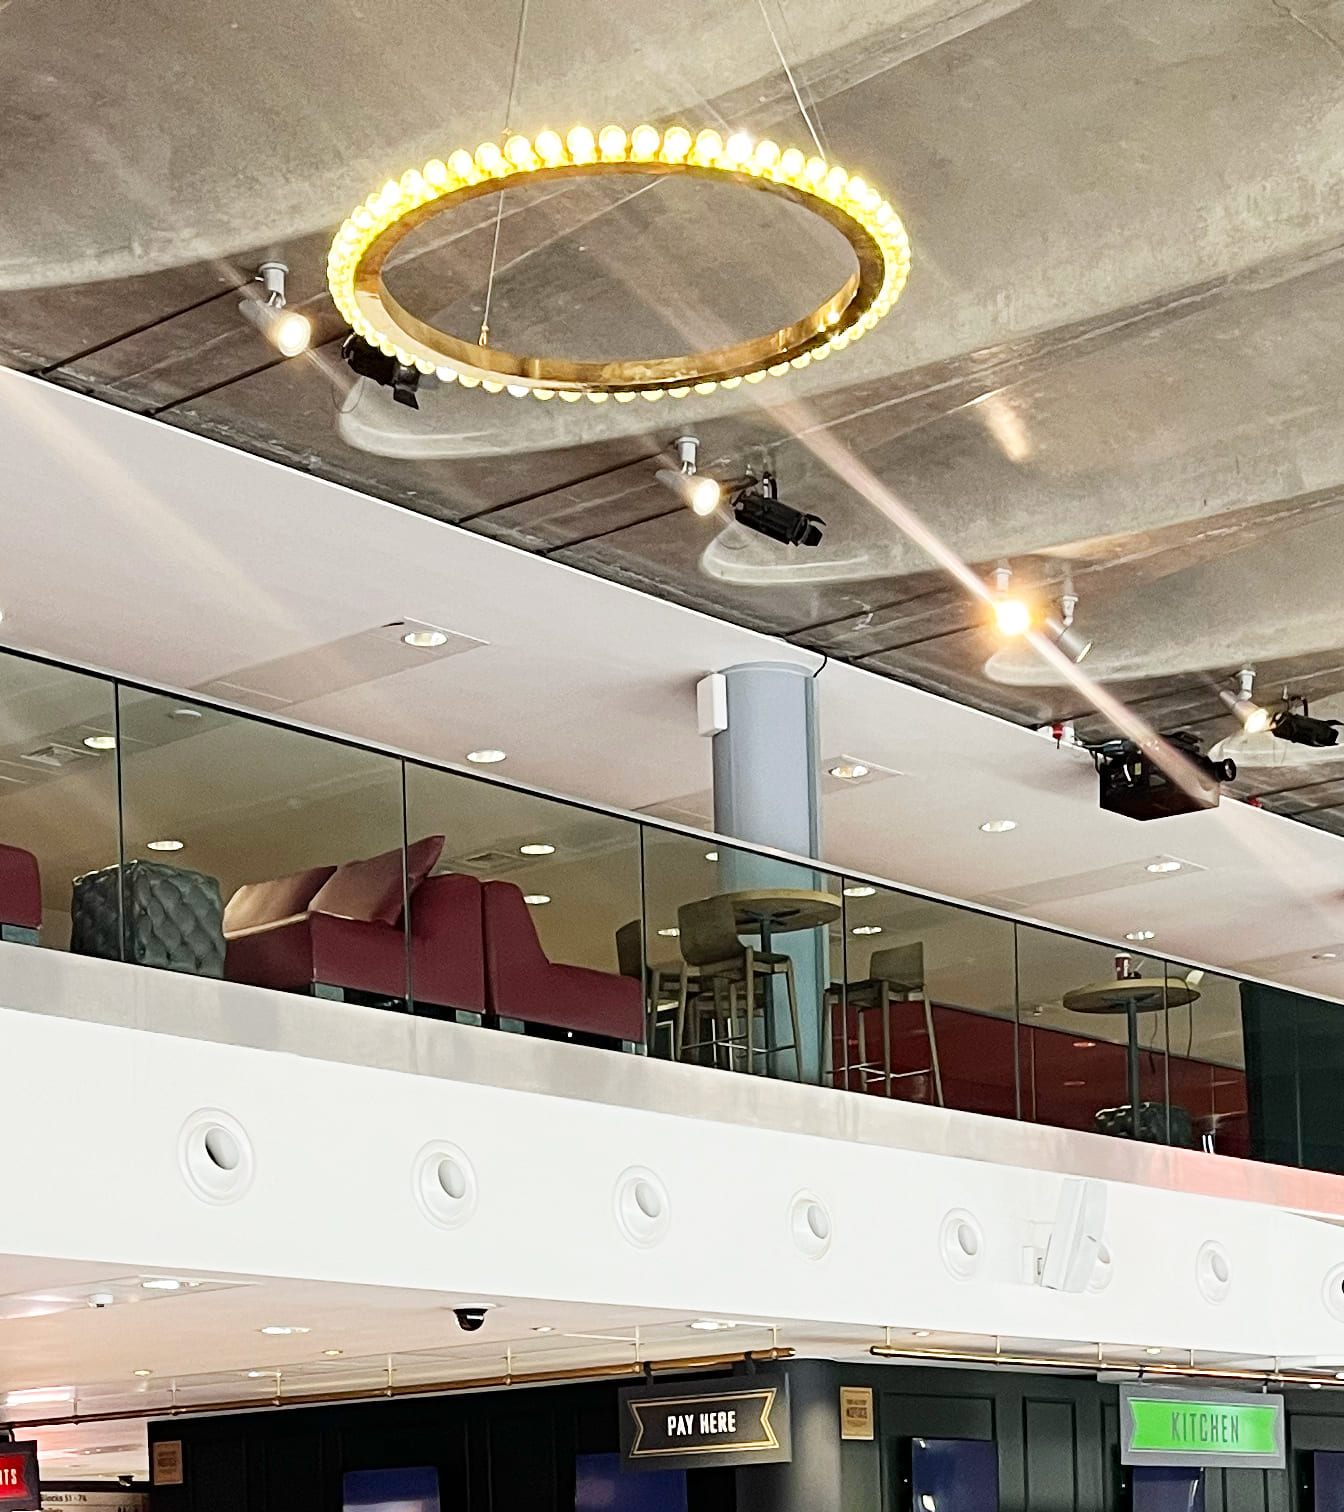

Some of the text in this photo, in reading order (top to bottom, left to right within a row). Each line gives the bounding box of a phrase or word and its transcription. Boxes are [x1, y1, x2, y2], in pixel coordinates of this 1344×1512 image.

[667, 1410, 736, 1436] PAY HERE
[1171, 1411, 1239, 1443] KITCHEN
